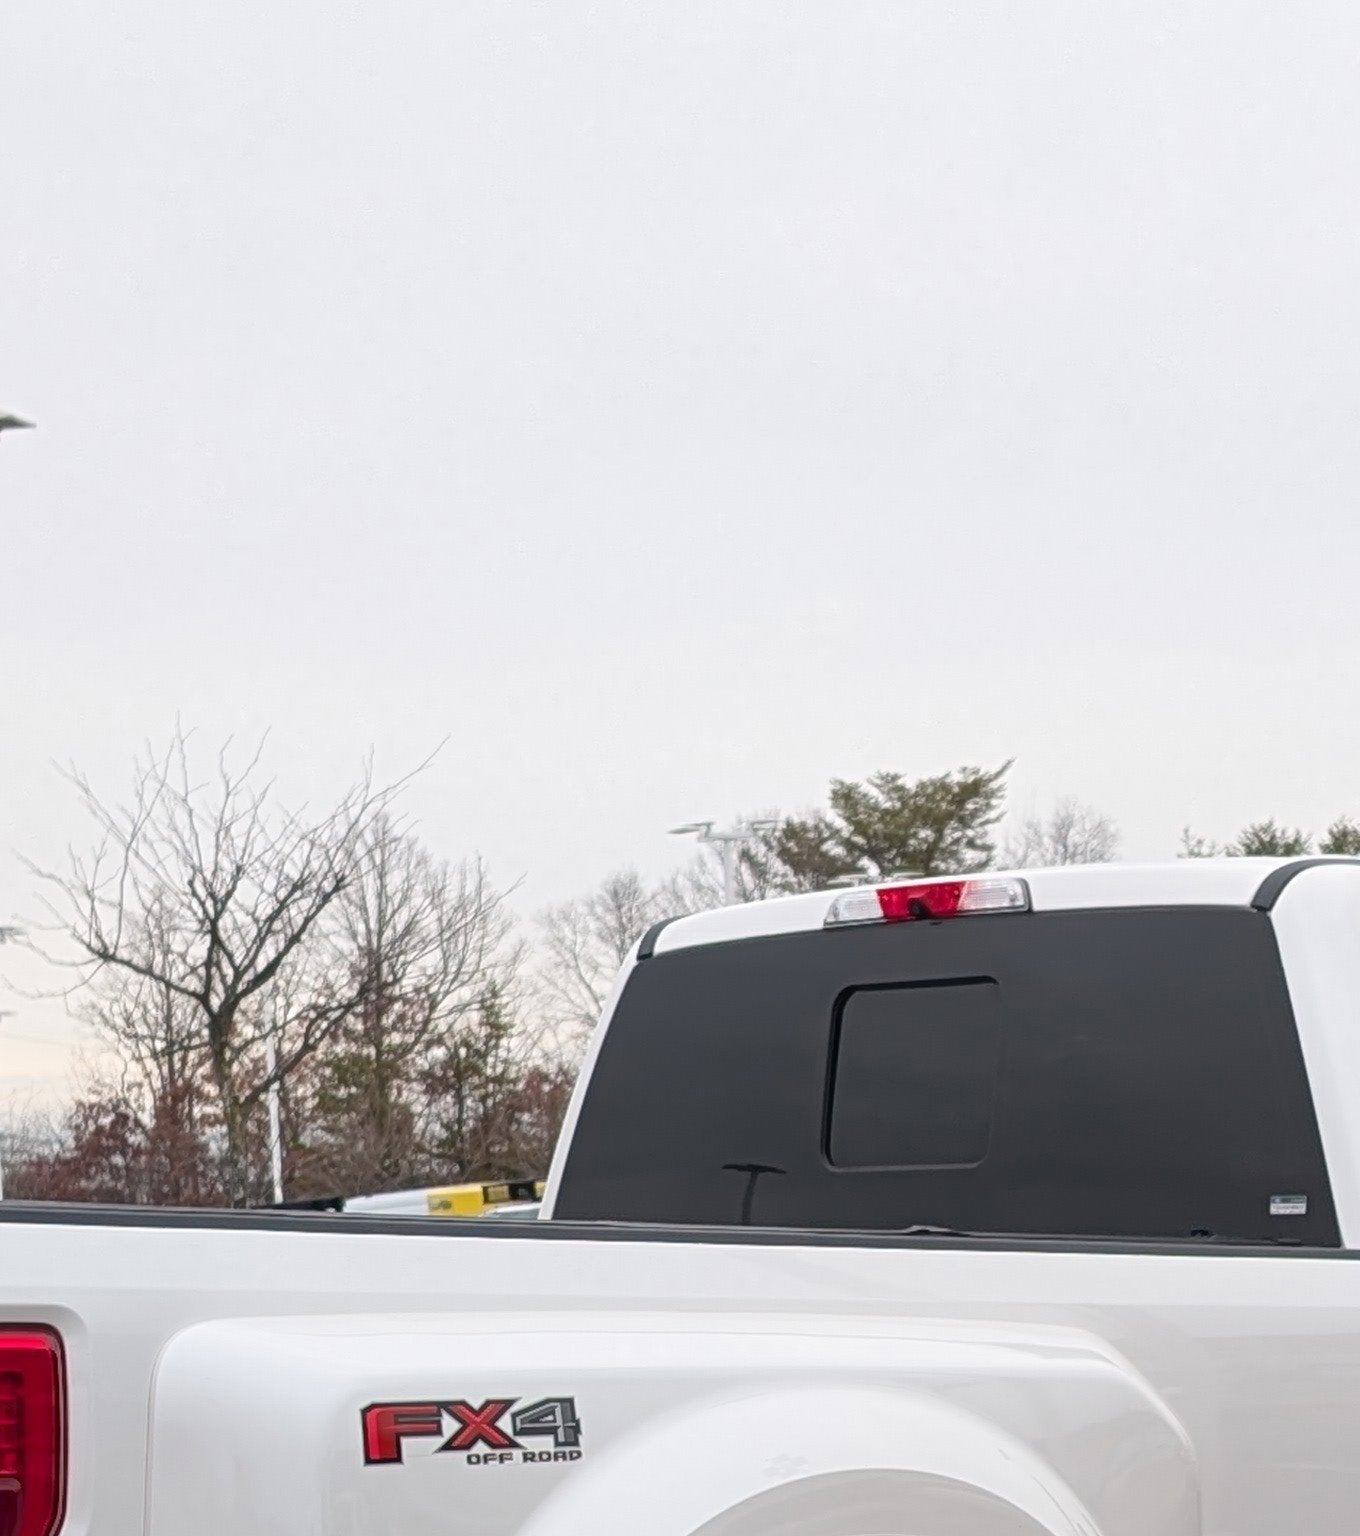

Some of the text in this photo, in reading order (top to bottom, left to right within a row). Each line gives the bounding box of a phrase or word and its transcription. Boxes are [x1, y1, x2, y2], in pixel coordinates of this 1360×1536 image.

[360, 1396, 582, 1466] FX4
[466, 1449, 583, 1465] OFF ROAD
